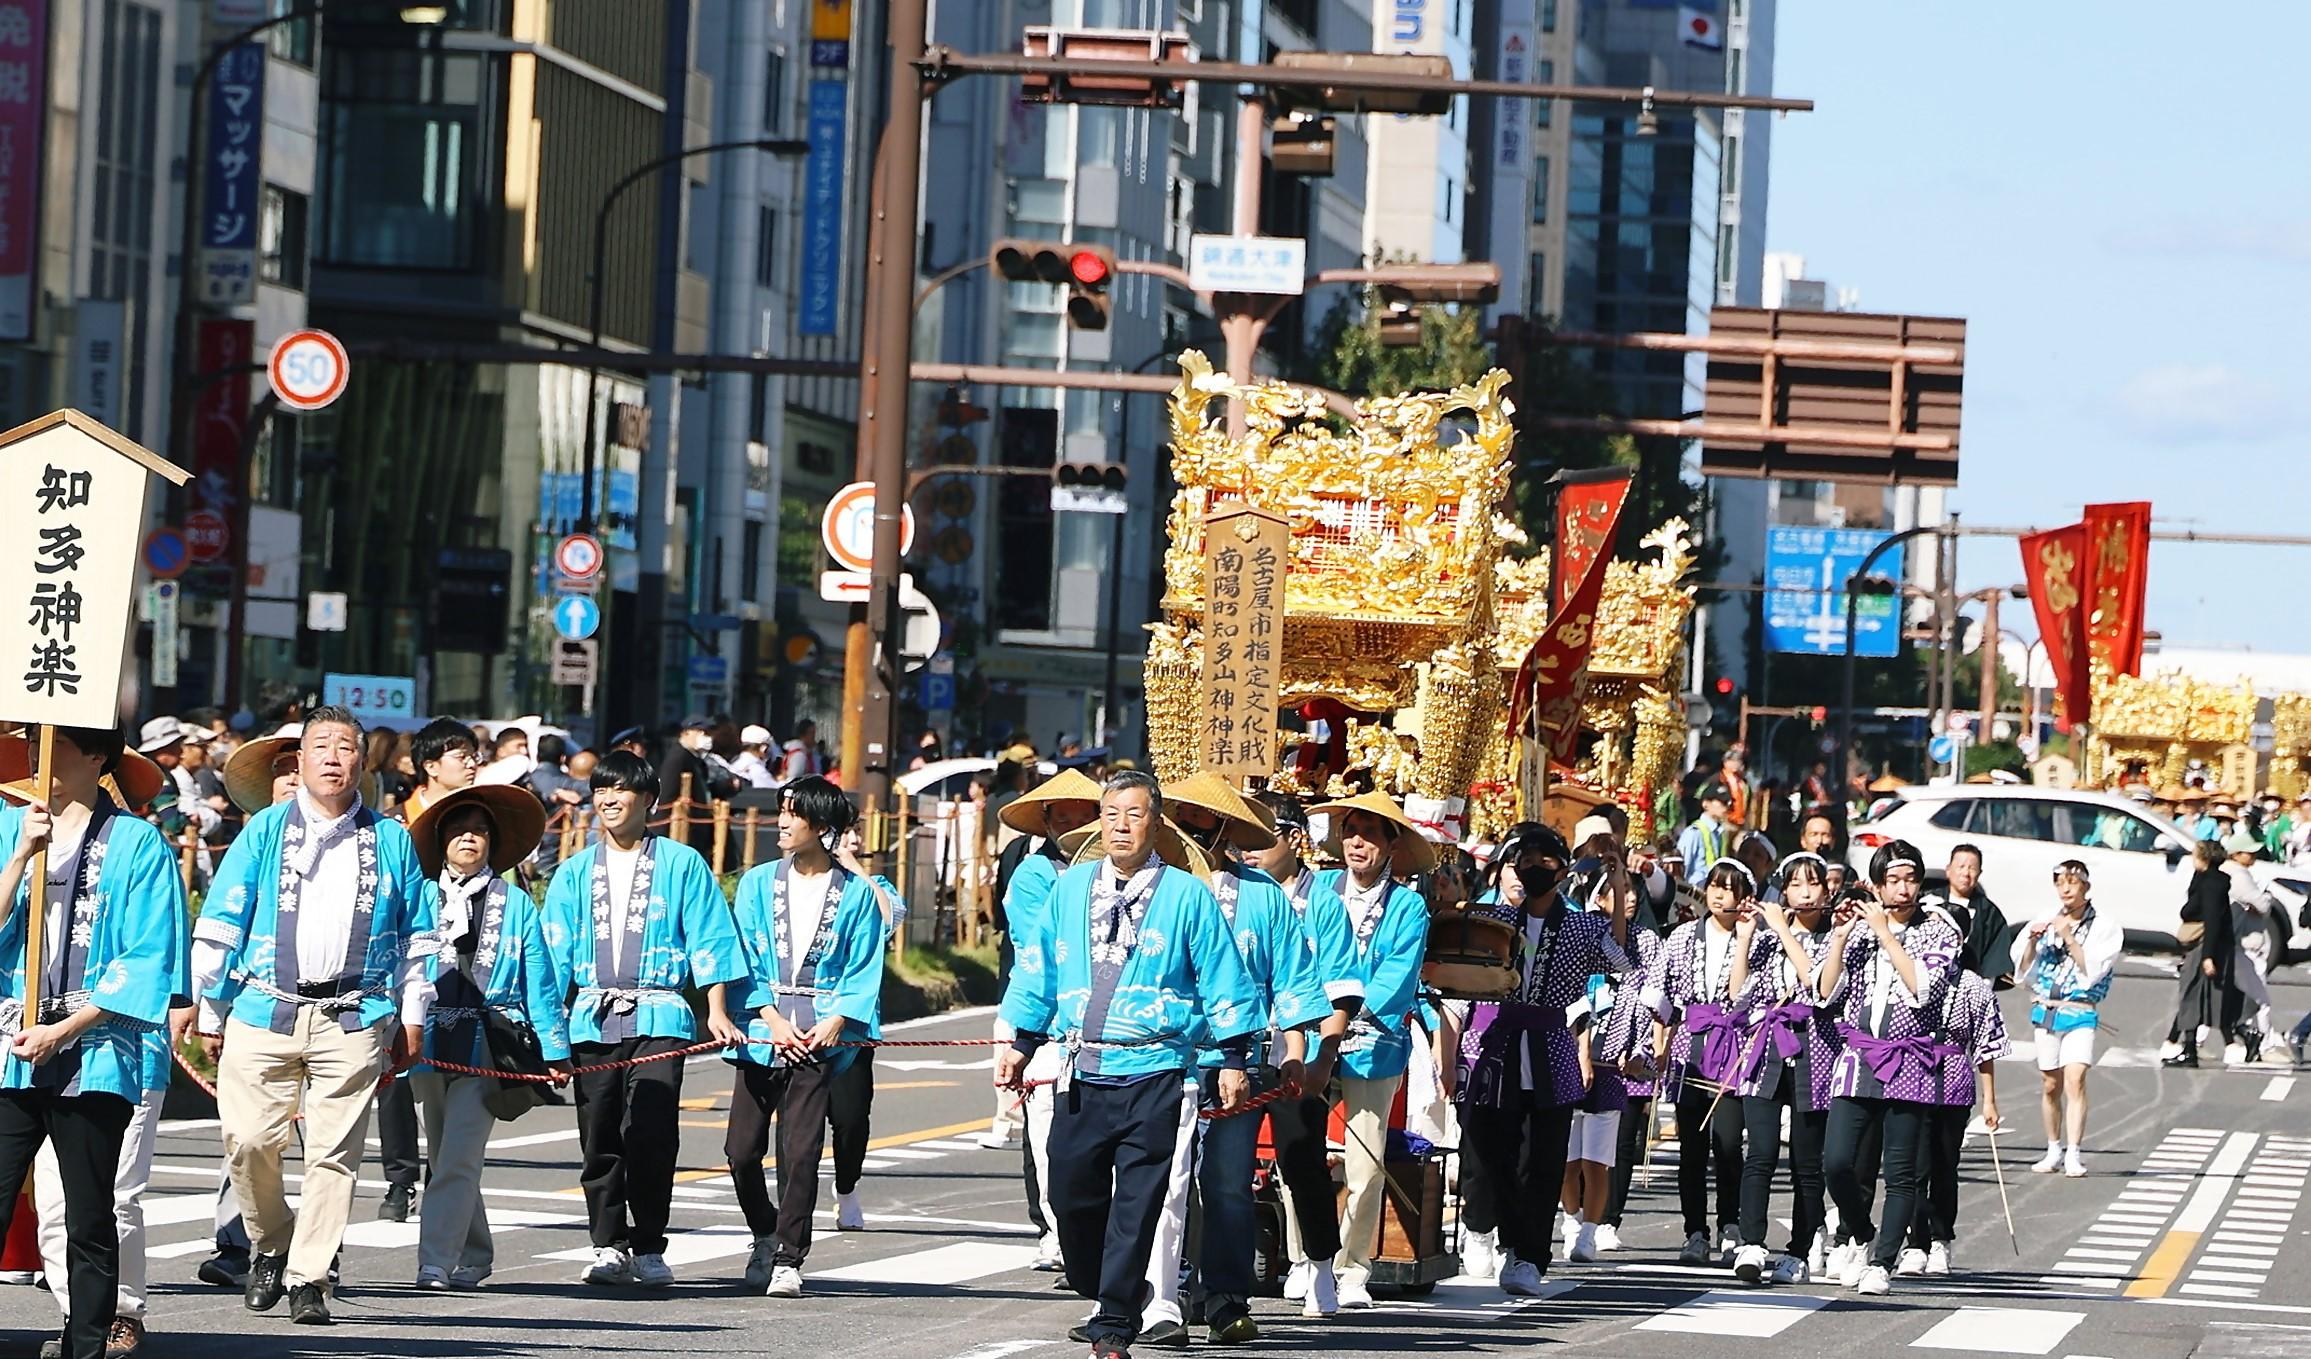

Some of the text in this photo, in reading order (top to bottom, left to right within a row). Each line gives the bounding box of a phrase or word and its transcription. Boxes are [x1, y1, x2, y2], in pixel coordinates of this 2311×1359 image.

[213, 84, 252, 245] マッサージ
[287, 350, 330, 386] 50
[24, 463, 93, 698] 知多神楽
[355, 827, 378, 914] 知多神楽
[591, 863, 611, 941] 知多神楽
[625, 854, 656, 934] 知多神楽
[476, 891, 507, 969] 知多神楽
